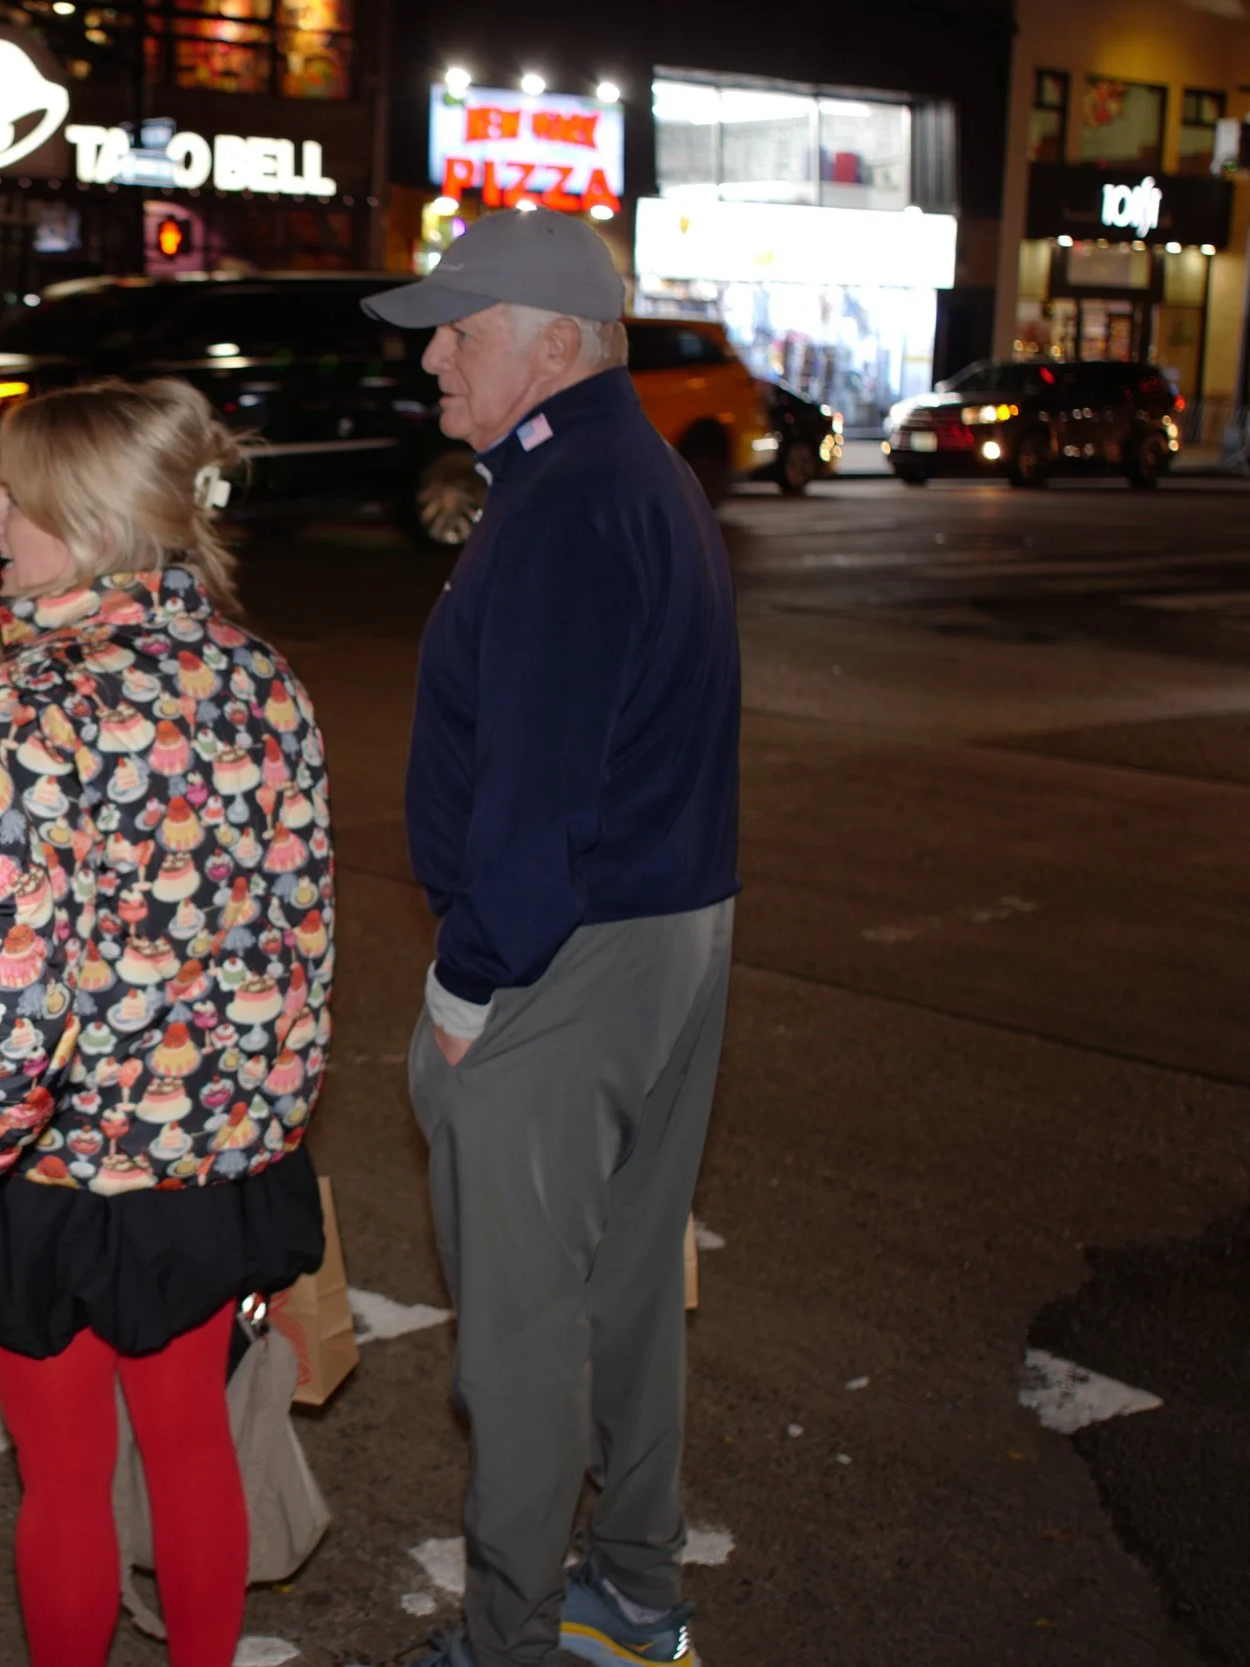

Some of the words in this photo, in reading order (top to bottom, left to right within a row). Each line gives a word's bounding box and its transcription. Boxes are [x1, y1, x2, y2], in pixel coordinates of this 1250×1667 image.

[65, 124, 212, 190] TAO
[213, 134, 337, 197] BELL
[442, 156, 621, 213] PIZZA
